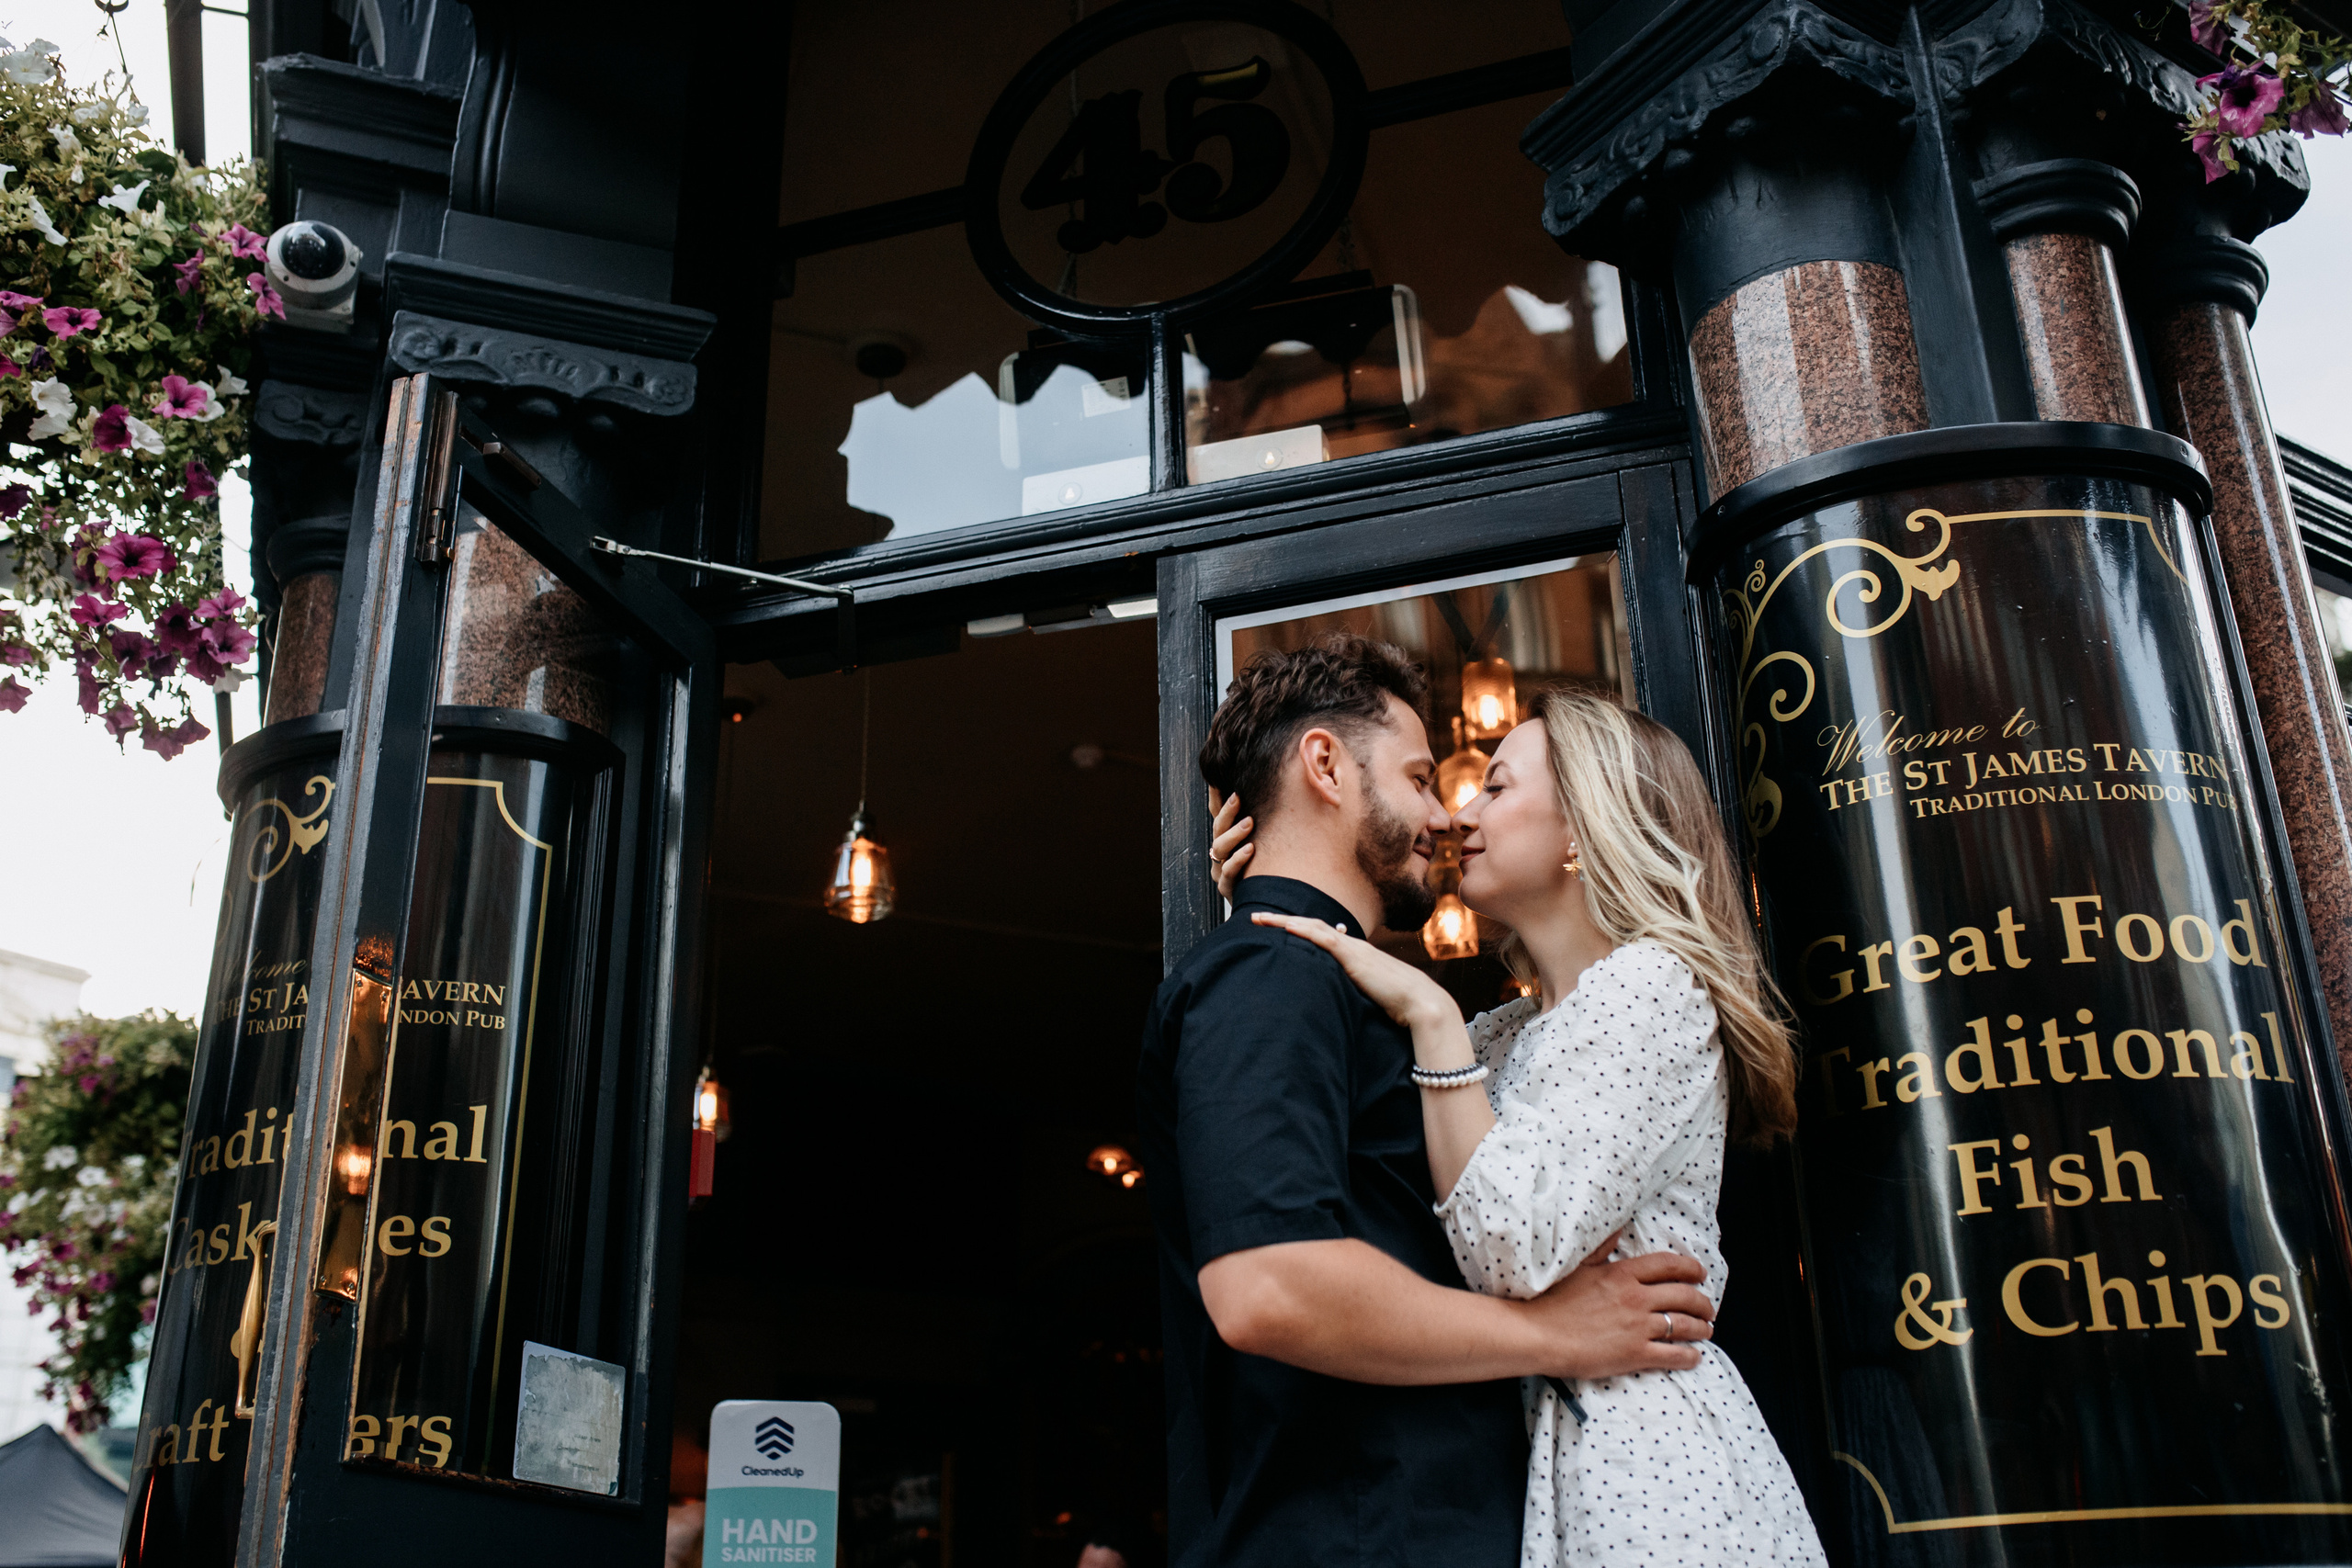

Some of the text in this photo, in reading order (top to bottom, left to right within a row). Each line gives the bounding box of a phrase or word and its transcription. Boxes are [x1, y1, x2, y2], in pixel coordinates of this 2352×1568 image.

[1021, 55, 1291, 254] 45
[1817, 707, 2040, 776] Welcome to
[1820, 743, 2230, 811] THE ST JAMES TAVERN
[1910, 781, 2238, 818] TRADITIONAL LONDON PUB
[1797, 895, 2267, 1006] Great Food
[246, 1010, 506, 1036] TRADIT NDON PUB
[248, 987, 277, 1013] ST
[401, 979, 506, 1006] AVERN
[1807, 1009, 2295, 1119] Traditional
[1948, 1126, 2163, 1216] Fish
[1894, 1250, 2290, 1356] & Chips
[741, 1466, 804, 1479] CleanedUp
[721, 1547, 817, 1562] SANITISER
[722, 1518, 818, 1544] HAND
